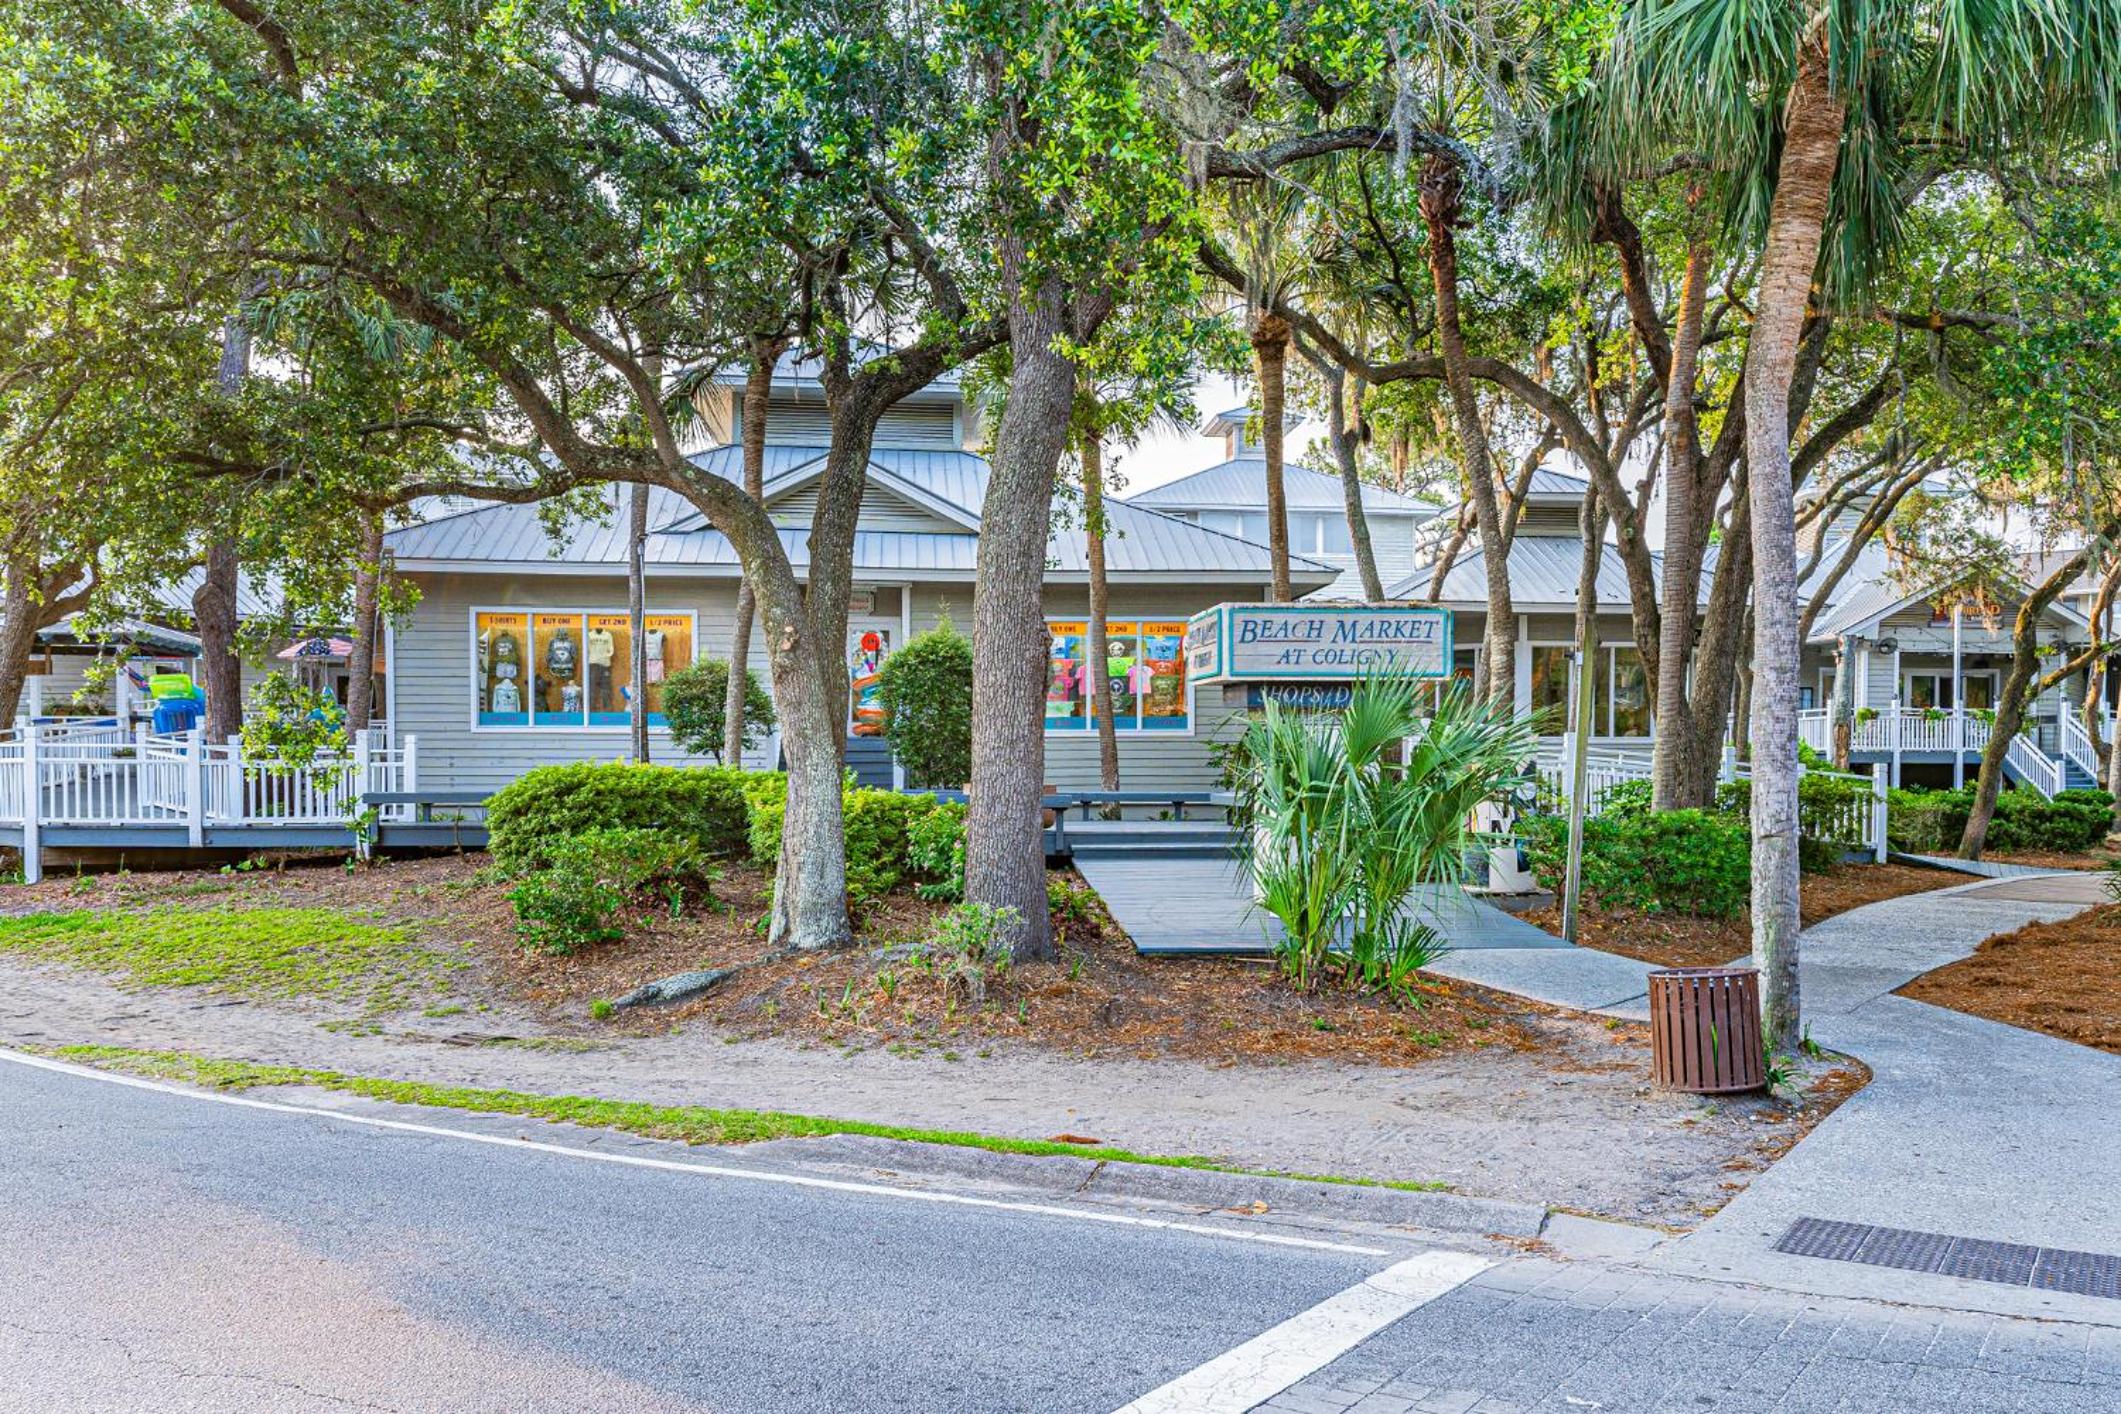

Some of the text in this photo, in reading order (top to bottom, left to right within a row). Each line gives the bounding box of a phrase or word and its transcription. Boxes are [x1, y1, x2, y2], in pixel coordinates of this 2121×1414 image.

[1162, 625, 1180, 633] PRICE
[1239, 619, 1326, 643] BEACH
[1331, 620, 1440, 644] MARKET
[1276, 649, 1307, 665] AT
